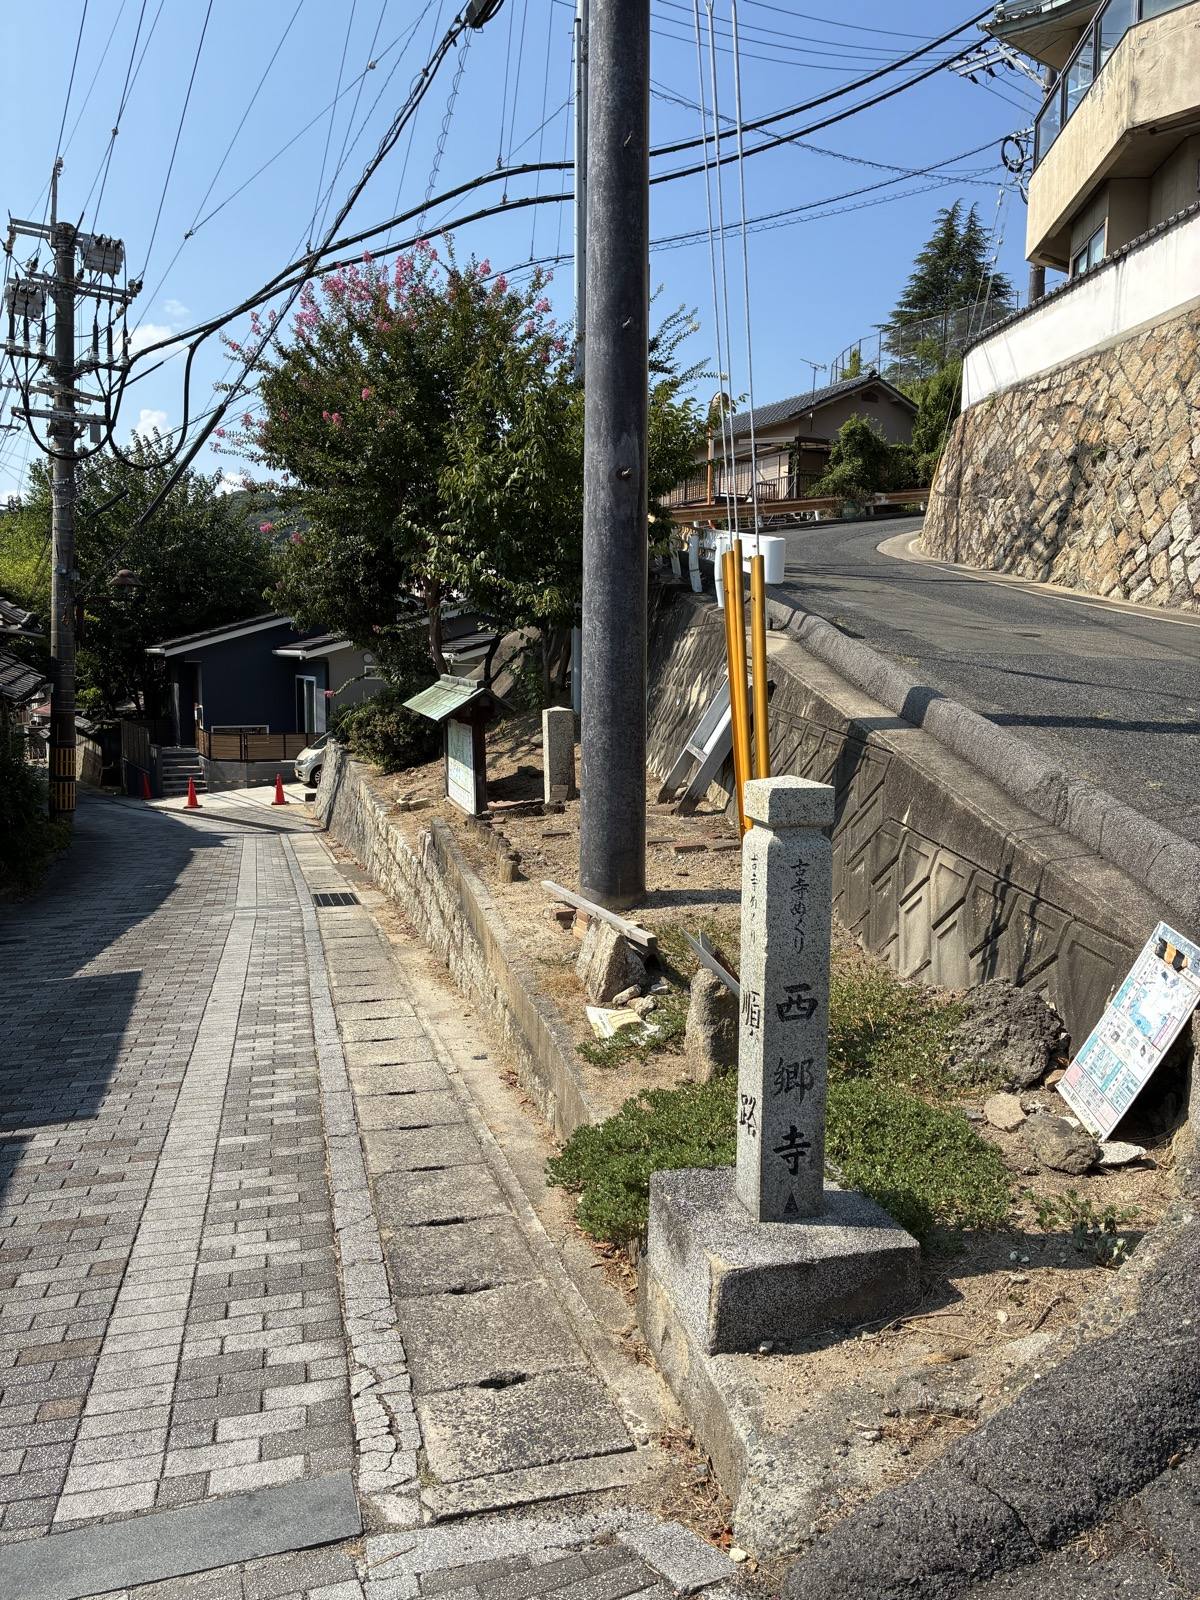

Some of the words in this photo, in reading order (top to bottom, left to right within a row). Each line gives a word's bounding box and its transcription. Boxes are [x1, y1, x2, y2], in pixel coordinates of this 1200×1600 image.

[790, 858, 811, 955] 古寺めぐり
[772, 982, 819, 1177] 西郷寺
